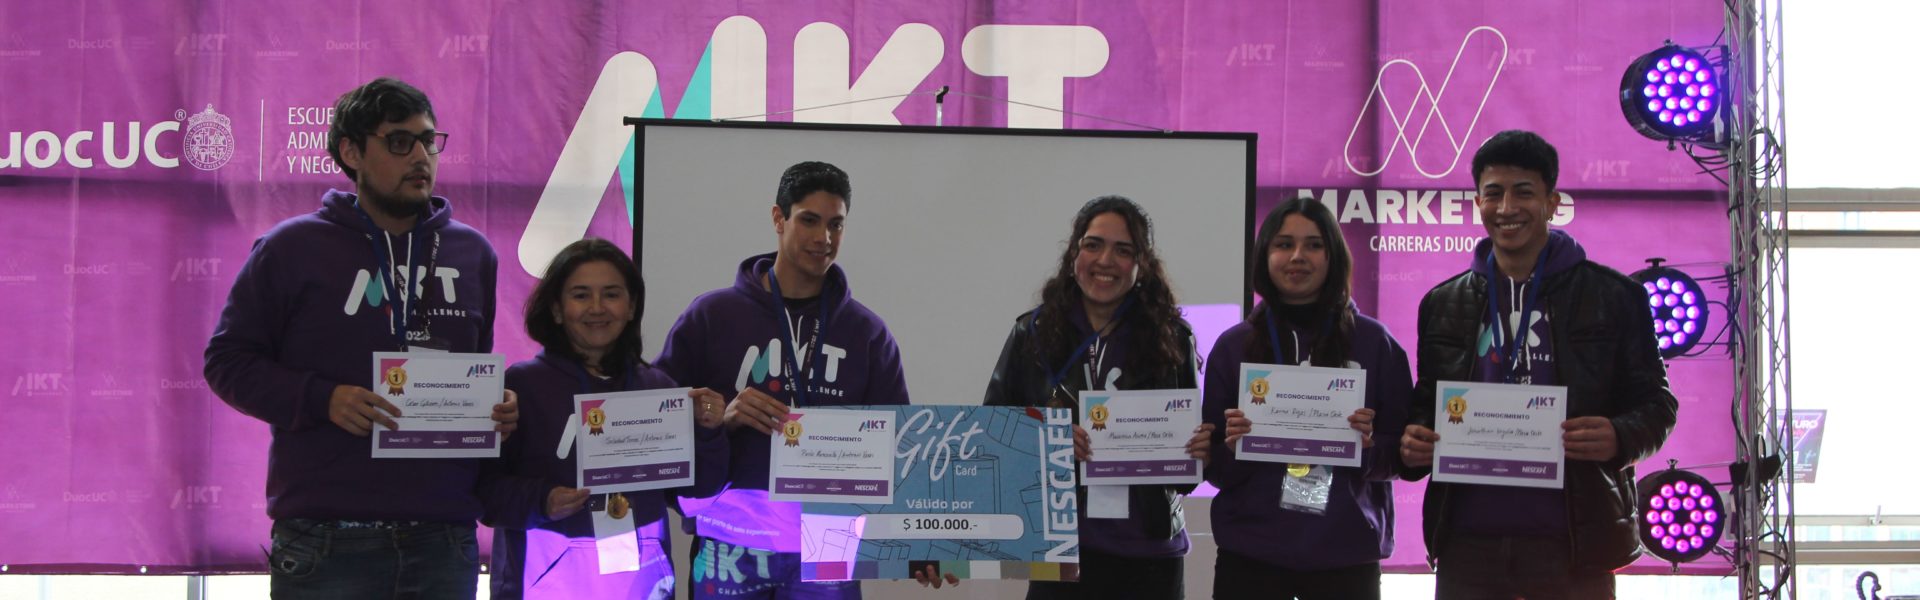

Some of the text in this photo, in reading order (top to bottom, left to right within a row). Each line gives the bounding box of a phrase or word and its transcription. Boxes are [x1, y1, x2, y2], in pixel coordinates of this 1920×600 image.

[286, 155, 297, 174] Y
[1297, 189, 1575, 226] MARKETG
[1369, 235, 1441, 253] CARRERAS
[1276, 392, 1331, 402] RECONOCIMIENTO
[1115, 416, 1169, 424] RECONOCIMIENTO
[1473, 411, 1531, 420] RECONOCIMIENTO
[611, 418, 663, 427] RECONOCIMIENTO
[808, 434, 863, 442] RECONOCIMIENTO
[894, 408, 984, 481] Gift
[954, 465, 978, 476] Card
[905, 498, 975, 511] Válido por
[902, 518, 978, 531] $ 100.000.-
